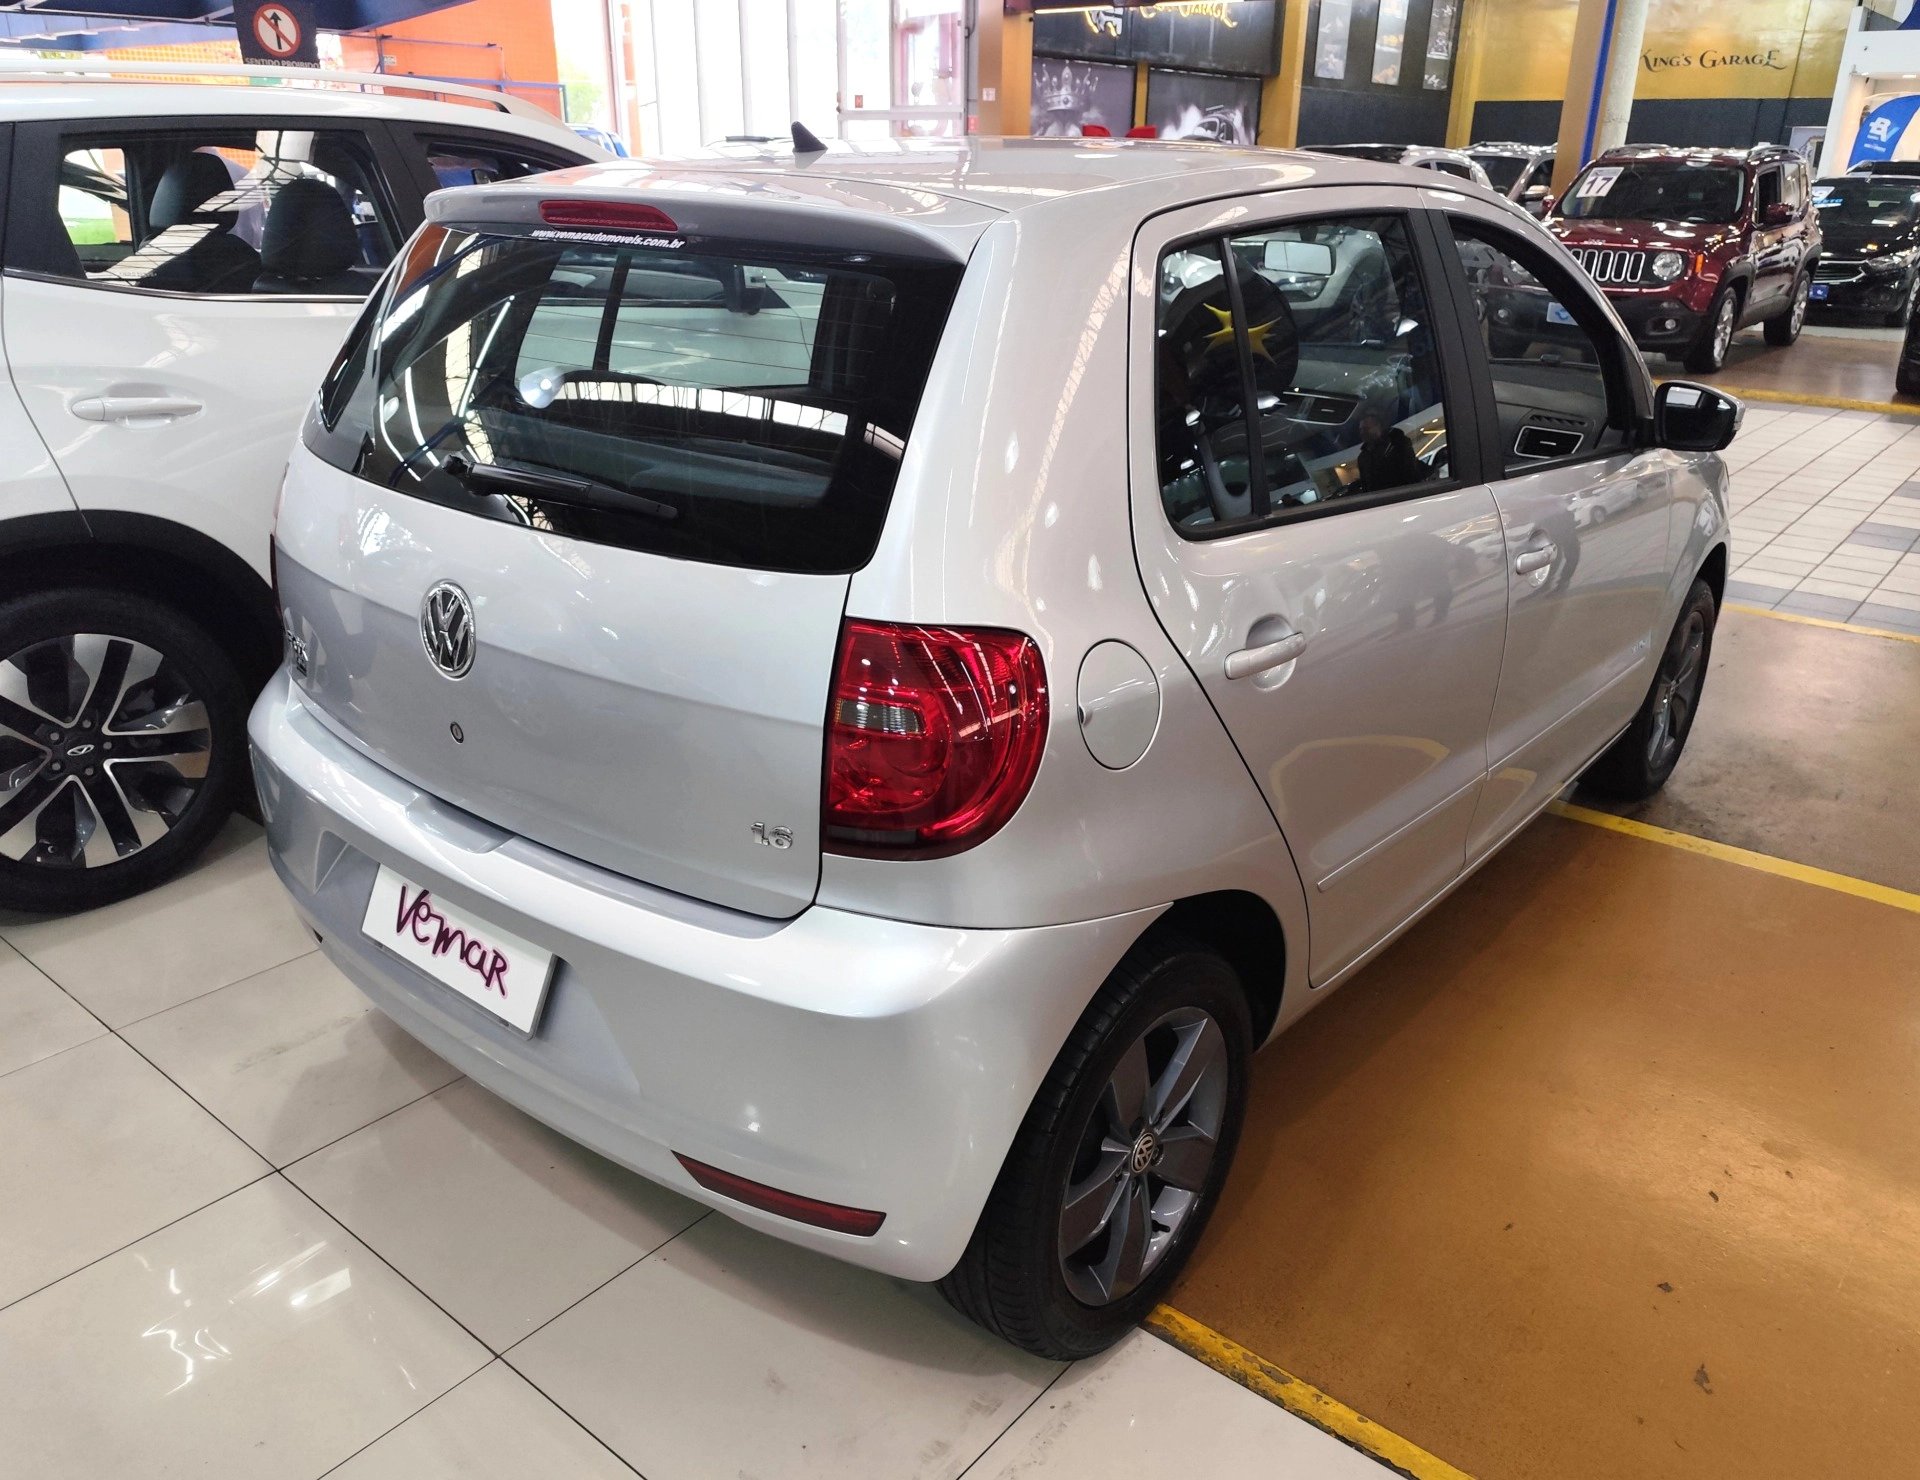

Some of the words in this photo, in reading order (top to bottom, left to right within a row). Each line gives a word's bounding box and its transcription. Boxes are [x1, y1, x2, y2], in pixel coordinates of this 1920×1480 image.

[245, 57, 280, 67] SENTIDO
[1700, 50, 1787, 70] GARAGE
[1586, 176, 1613, 195] 17
[750, 821, 793, 850] 1.6
